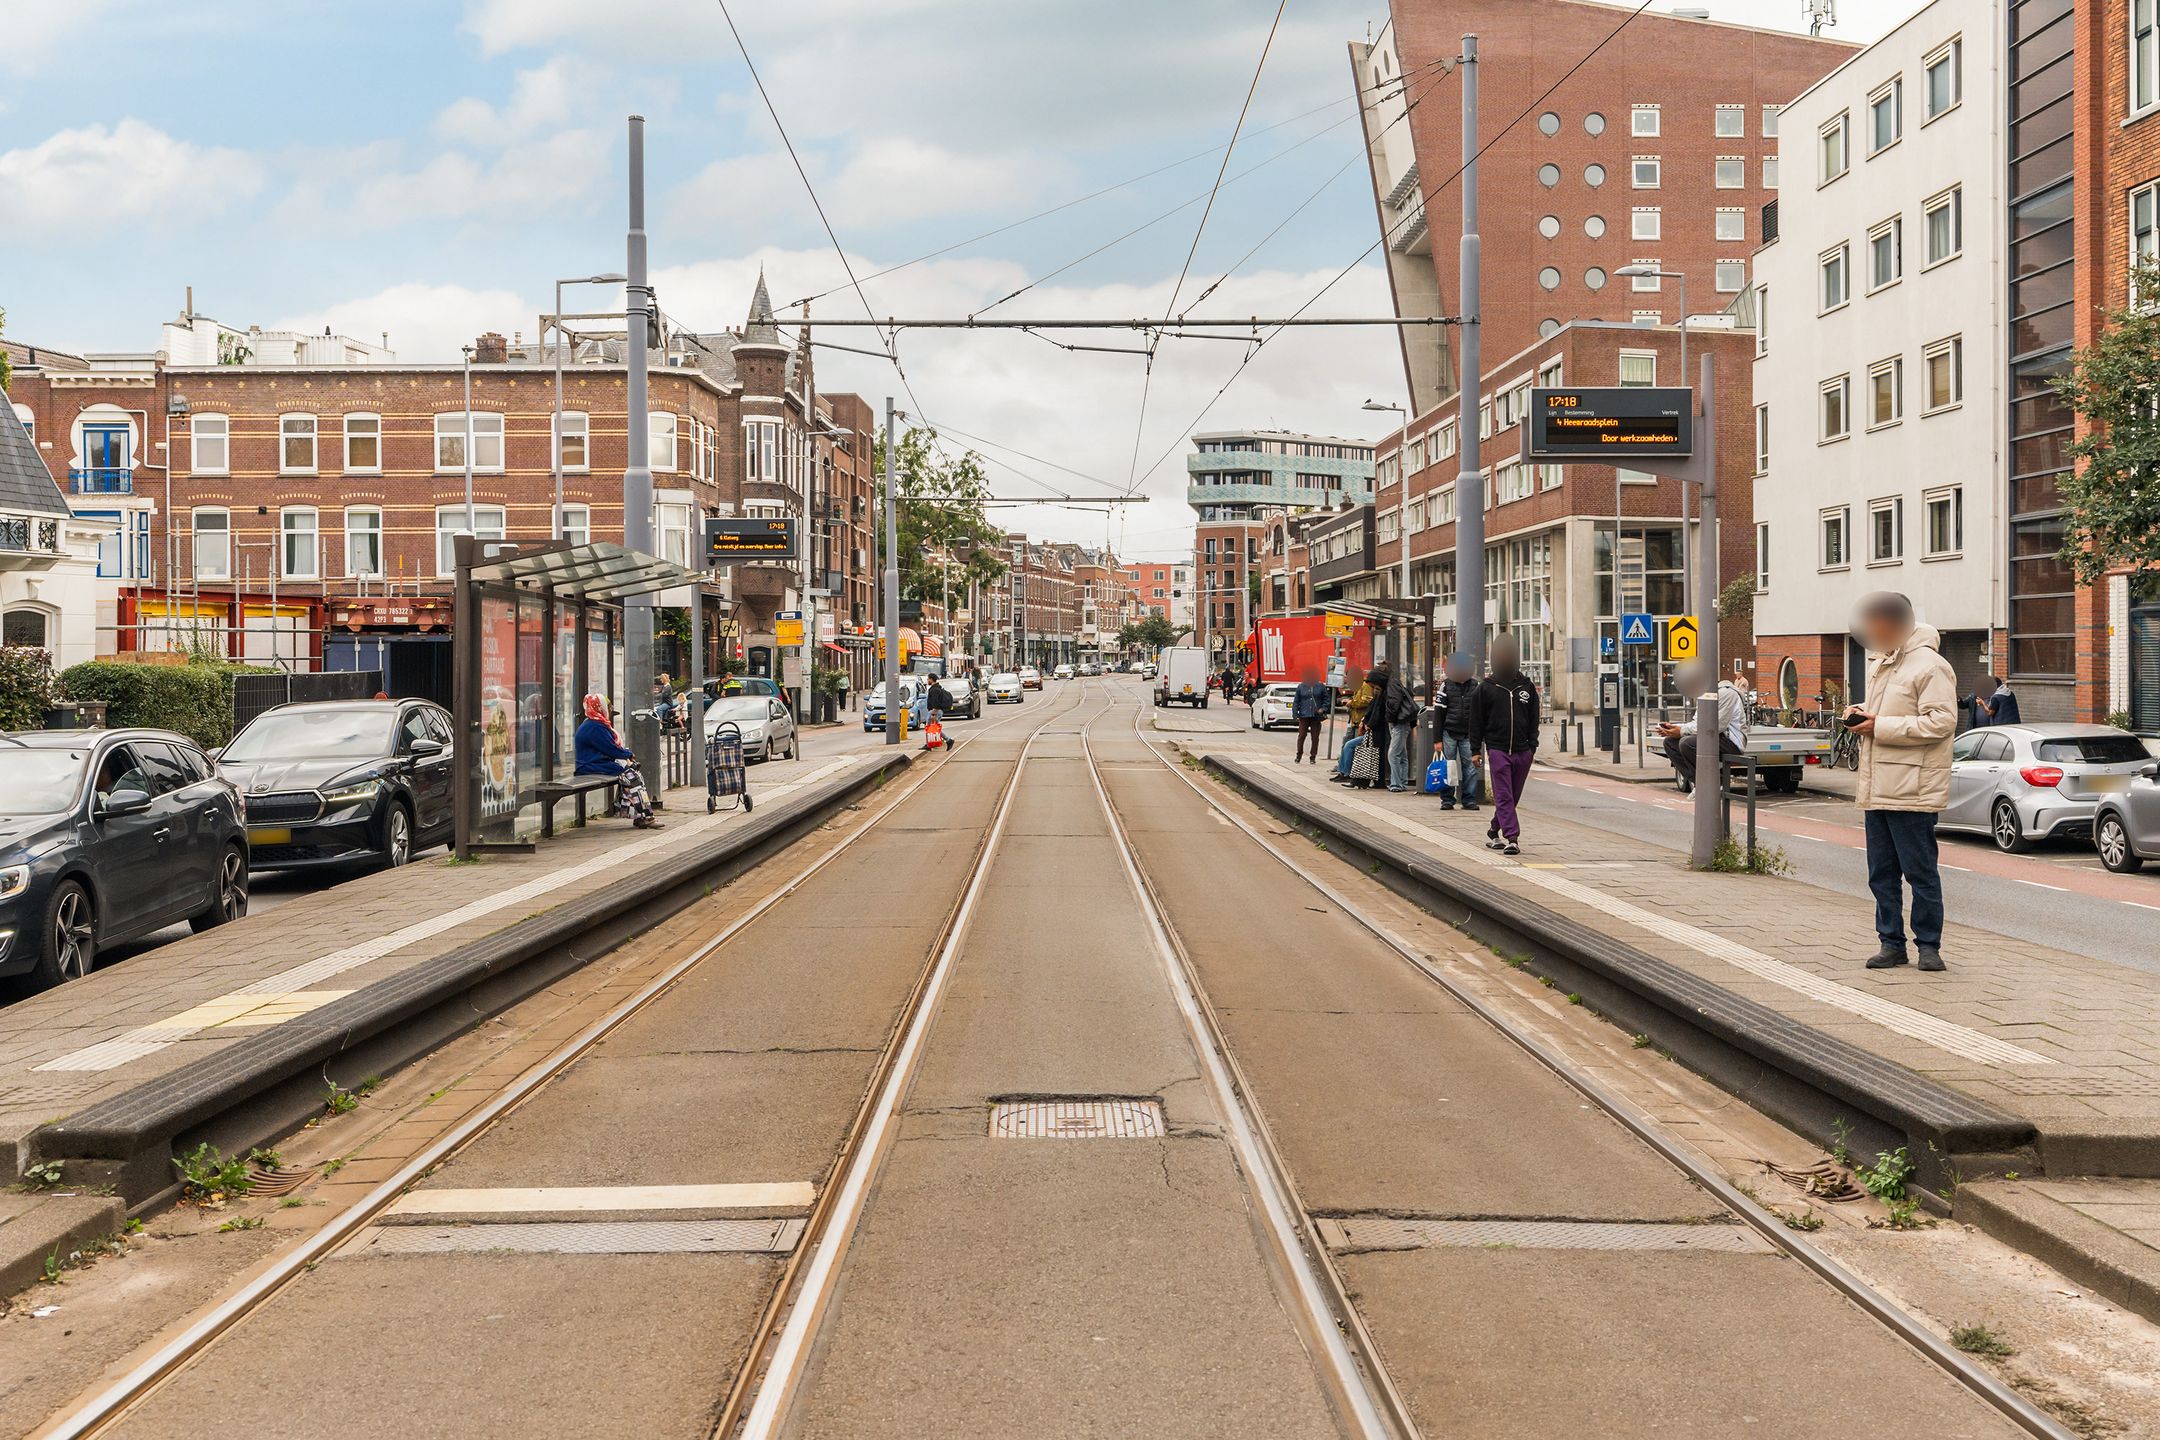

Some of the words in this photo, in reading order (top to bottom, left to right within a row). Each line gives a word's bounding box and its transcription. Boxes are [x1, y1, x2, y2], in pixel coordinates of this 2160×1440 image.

[1549, 397, 1577, 407] 17:18
[1557, 418, 1562, 426] 4
[1601, 434, 1618, 442] Door
[1620, 434, 1673, 442] werkzaamheden
[768, 522, 785, 530] 17:18
[1607, 638, 1614, 647] P
[1261, 627, 1286, 672] Dirk
